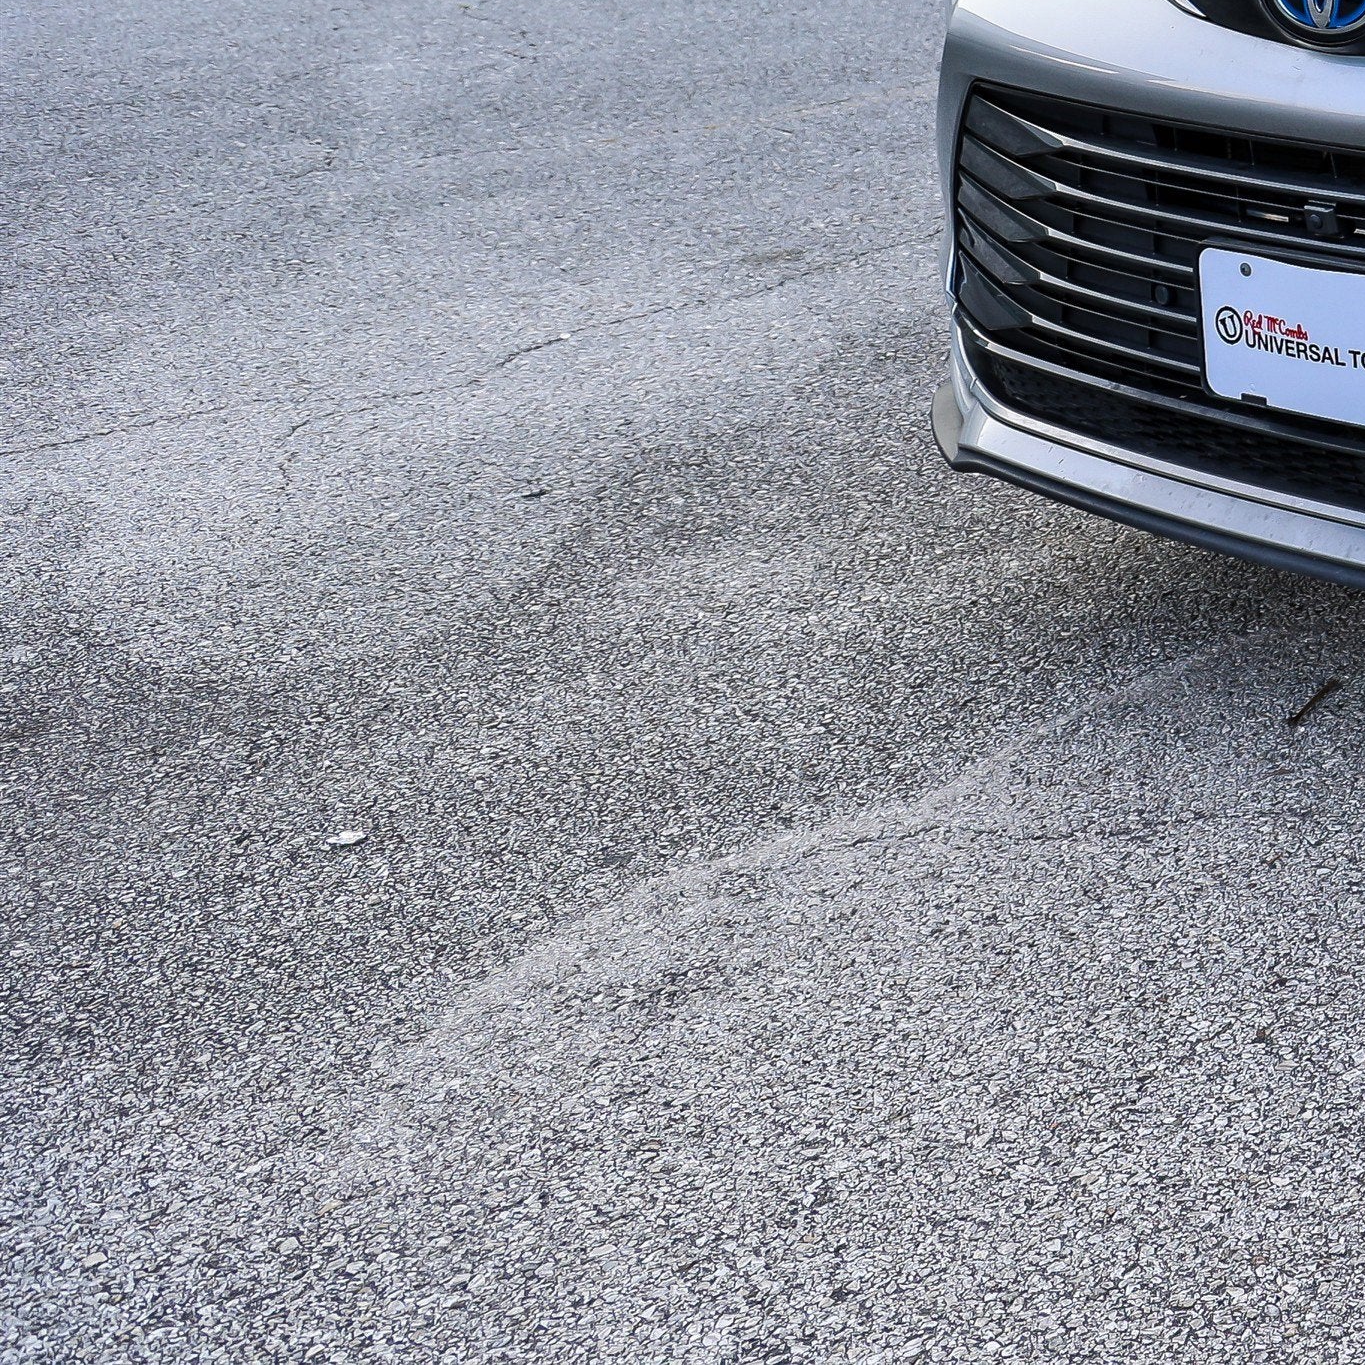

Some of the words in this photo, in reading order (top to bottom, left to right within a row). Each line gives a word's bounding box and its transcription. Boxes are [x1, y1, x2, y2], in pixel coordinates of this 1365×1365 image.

[1243, 310, 1263, 335] Red
[1264, 315, 1308, 341] McCombs
[1245, 329, 1346, 367] UNIVERSAL
